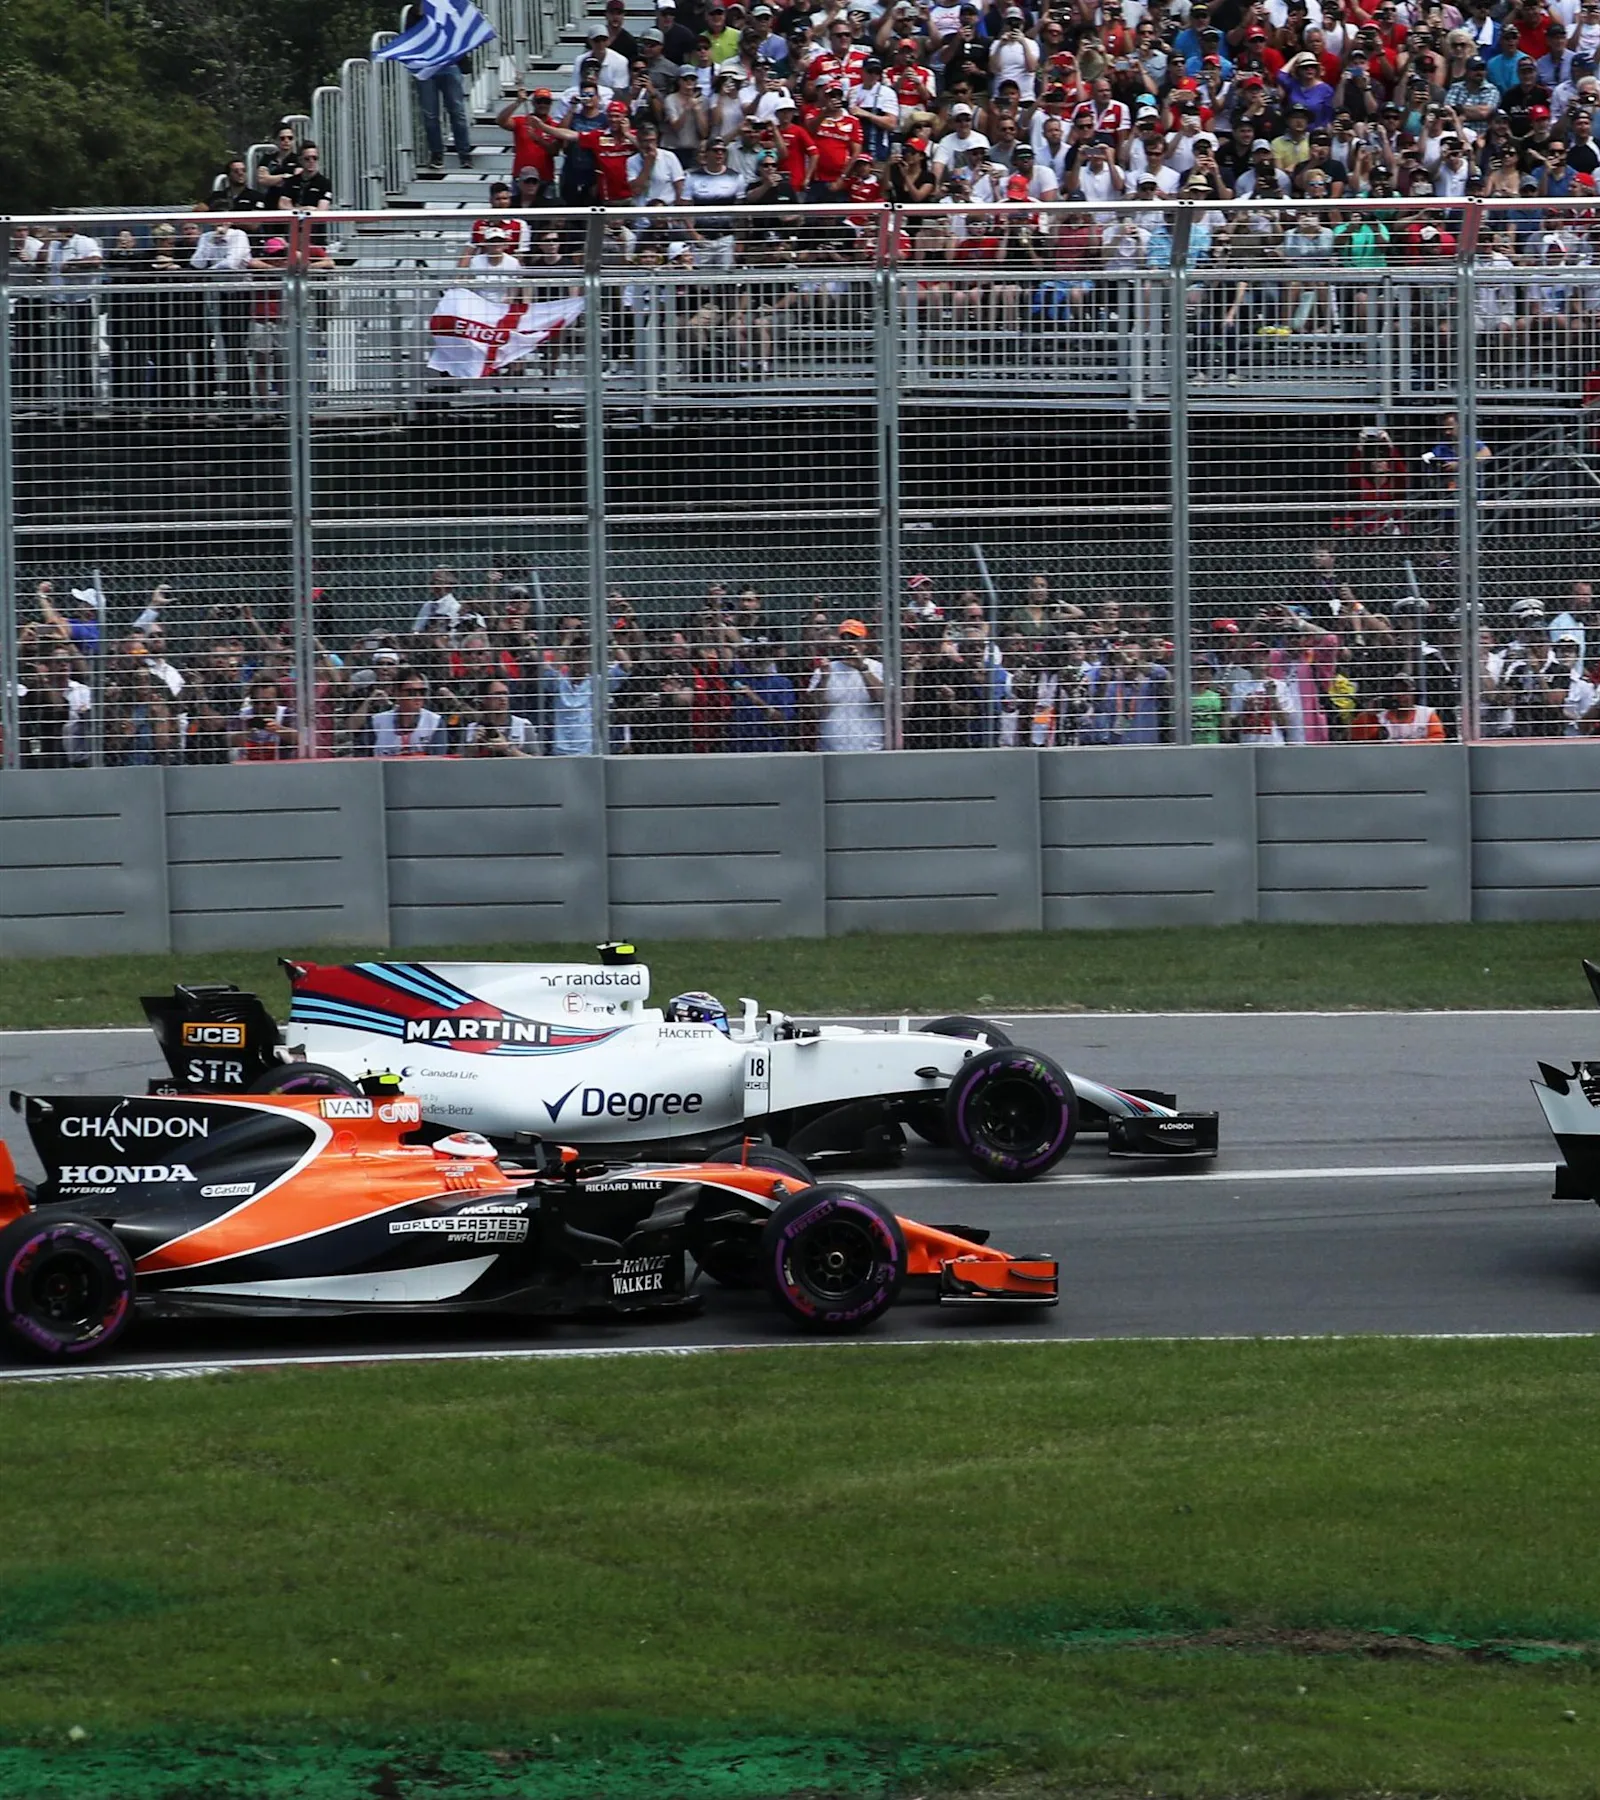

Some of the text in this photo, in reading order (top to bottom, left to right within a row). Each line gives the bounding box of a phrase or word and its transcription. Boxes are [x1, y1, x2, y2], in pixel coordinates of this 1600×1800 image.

[453, 319, 507, 344] ENGL
[566, 971, 641, 986] randstad
[187, 1027, 241, 1044] JCB
[407, 1018, 549, 1043] MARTINI
[659, 1027, 714, 1039] HACKETT
[187, 1058, 243, 1084] STR
[420, 1068, 479, 1081] Canada Life
[751, 1058, 765, 1077] 18
[744, 1081, 768, 1090] JCB
[1009, 1059, 1064, 1098] ZERO
[329, 1100, 370, 1115] VAN
[378, 1102, 419, 1123] CNN
[421, 1104, 474, 1116] edes-Benz
[581, 1088, 703, 1122] Degree
[60, 1116, 209, 1138] CHANDON
[1158, 1122, 1194, 1131] #LONDON
[58, 1164, 198, 1184] HONDA
[58, 1186, 118, 1194] HYBRID
[214, 1184, 251, 1196] Castrol
[585, 1181, 663, 1192] RICHARD MILLE
[457, 1202, 529, 1215] McLaren
[391, 1218, 528, 1232] WORLD'S FASTEST
[447, 1231, 527, 1242] #WFG GAMER
[613, 1272, 663, 1296] WALKER
